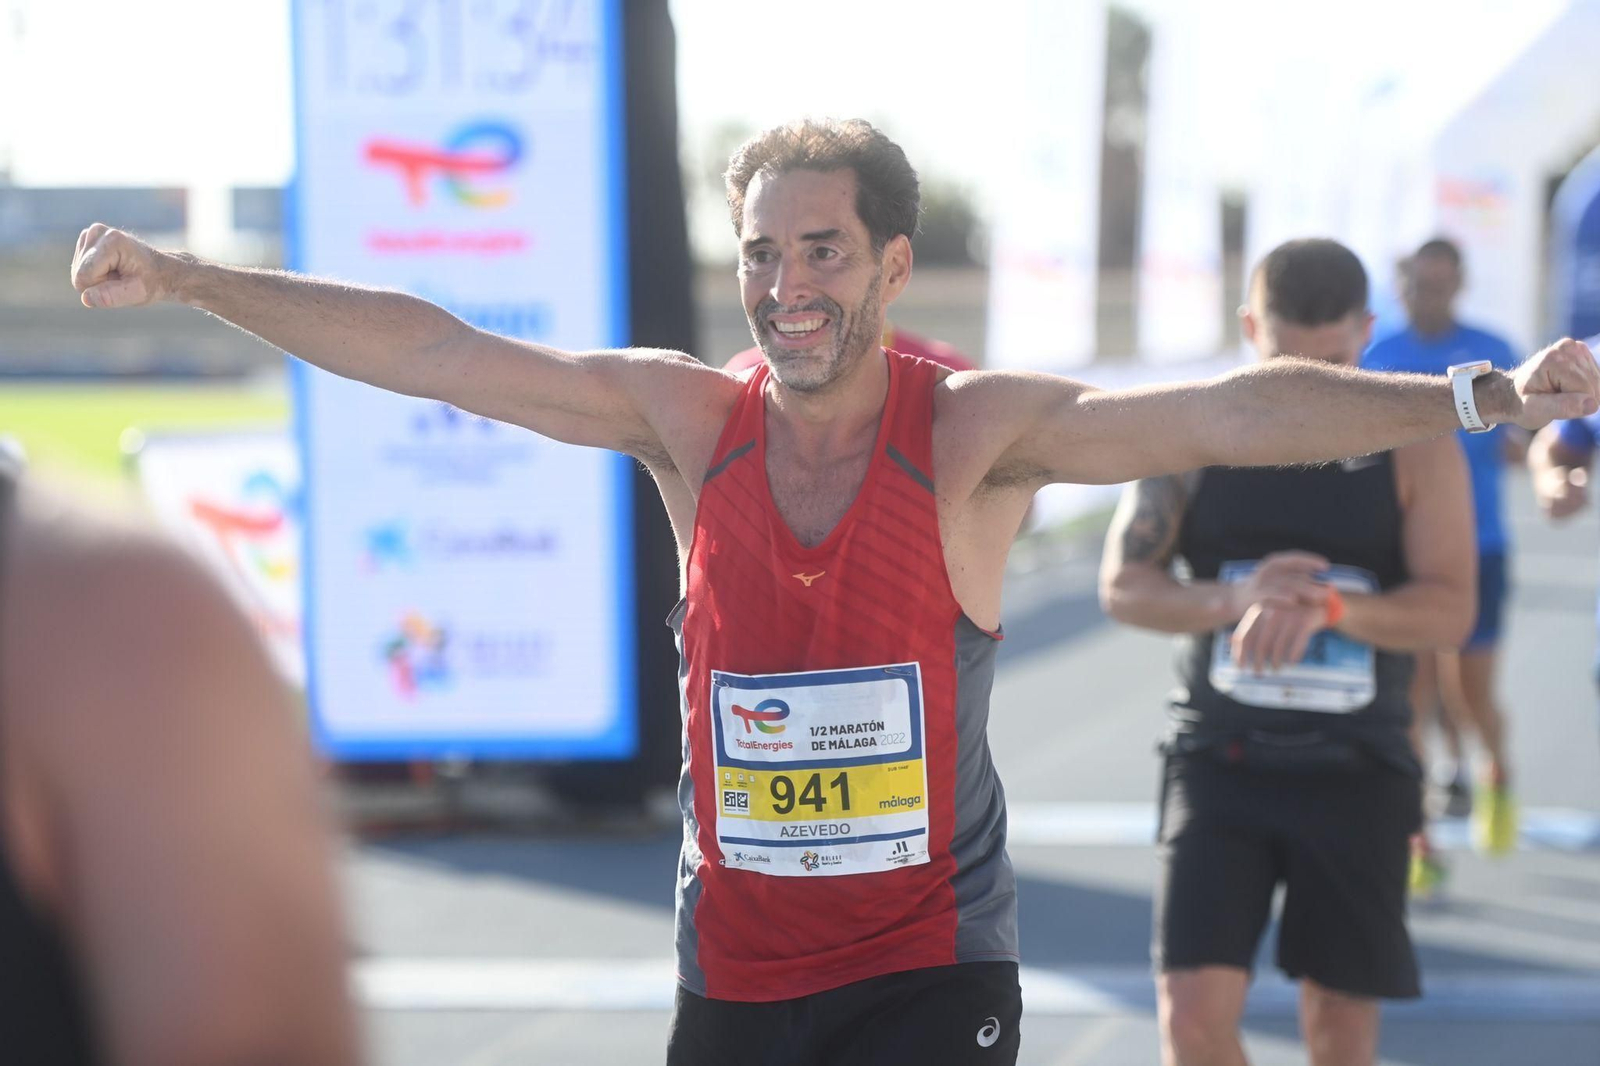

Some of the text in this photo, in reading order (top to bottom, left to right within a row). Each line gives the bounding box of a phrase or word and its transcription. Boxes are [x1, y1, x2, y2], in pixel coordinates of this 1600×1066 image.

[810, 720, 885, 737] 1/2 MARATÓN
[736, 738, 793, 752] TotalEnergies
[811, 732, 906, 751] DE MÁLAGA 2022
[770, 771, 850, 815] 941
[879, 795, 921, 809] málaga
[780, 823, 851, 838] AZEVEDO
